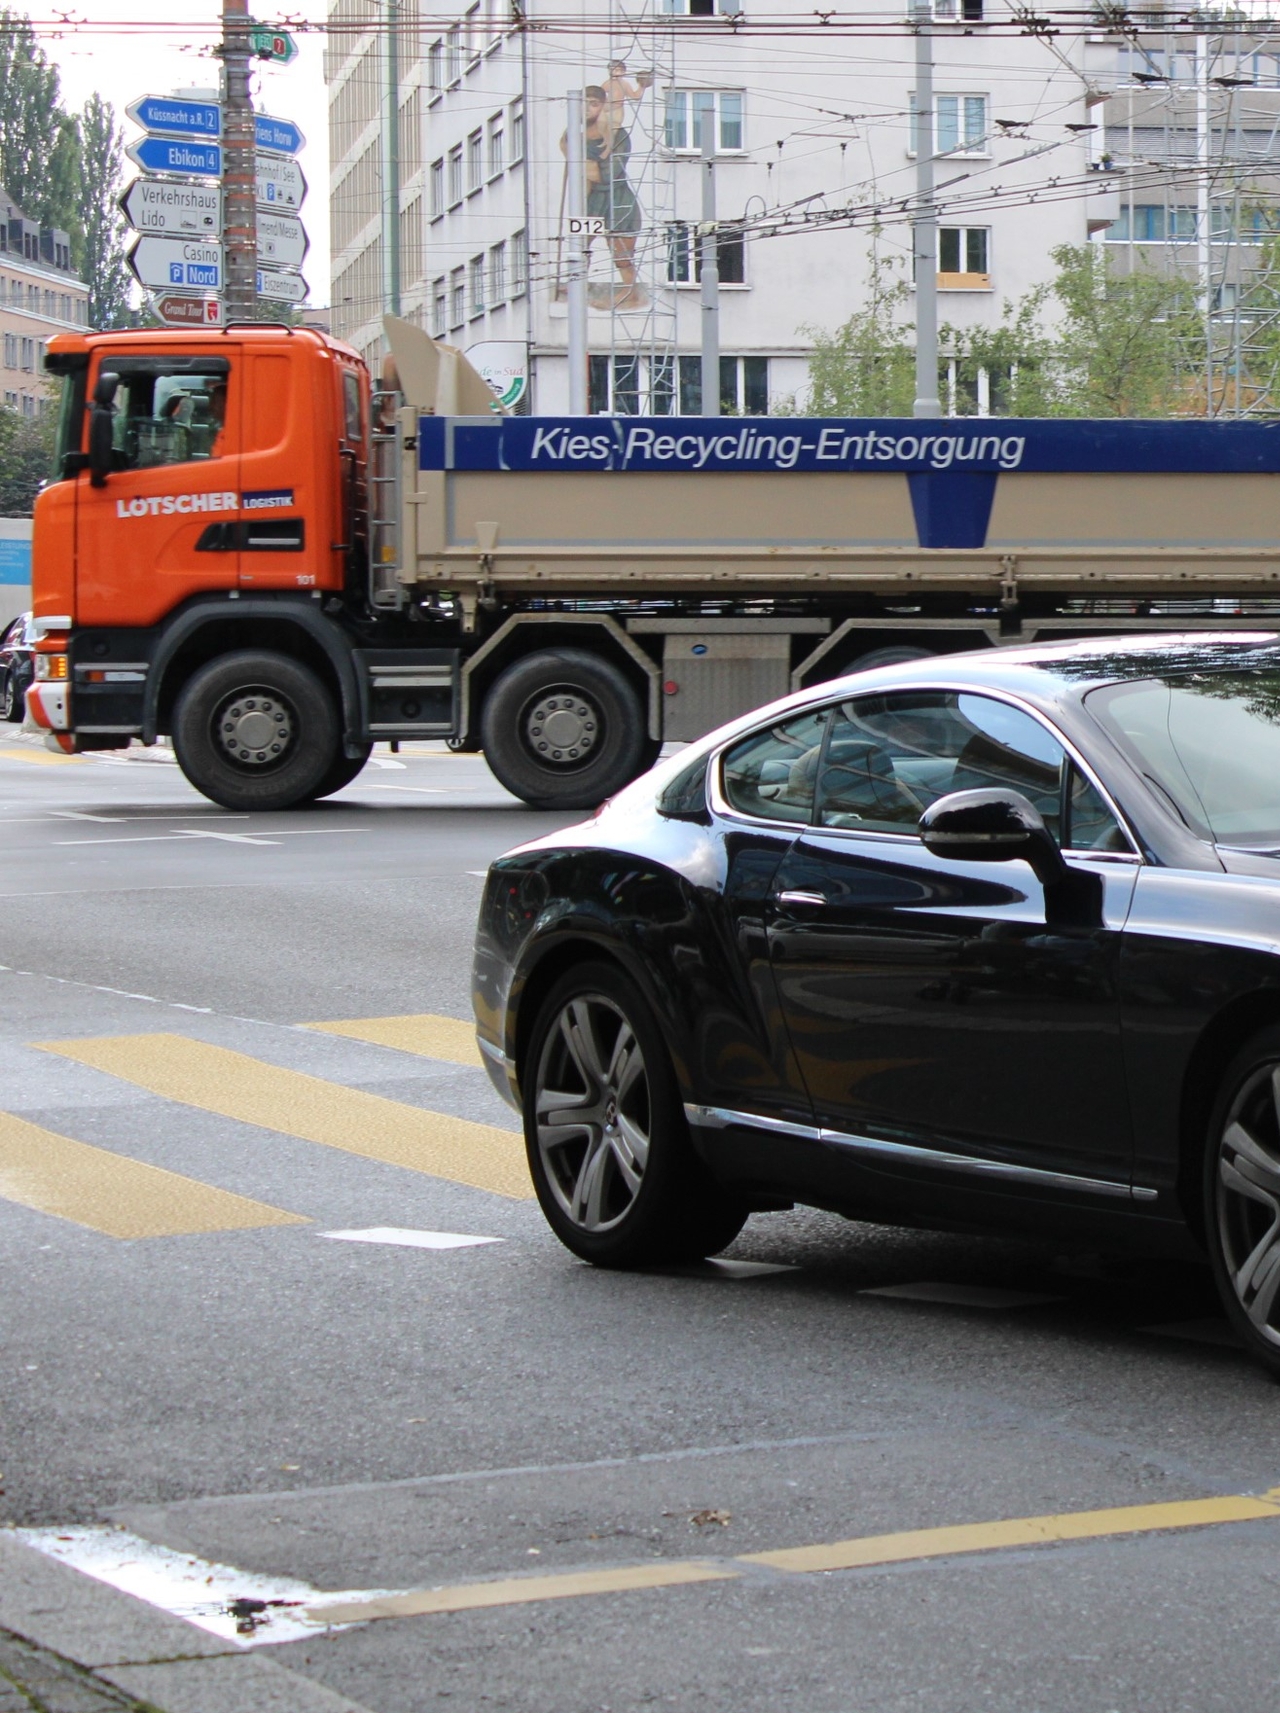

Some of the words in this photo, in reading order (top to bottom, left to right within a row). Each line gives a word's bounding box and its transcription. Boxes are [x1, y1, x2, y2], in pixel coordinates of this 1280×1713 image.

[147, 107, 188, 124] Küssnacht
[189, 113, 204, 126] a.R.
[208, 112, 214, 127] 2
[256, 124, 272, 142] riens
[273, 127, 292, 146] Horw
[168, 148, 205, 167] Ebikon
[208, 153, 215, 167] 4
[142, 186, 217, 209] Verkehrshaus
[141, 210, 165, 227] Lido
[570, 220, 603, 234] D12
[183, 245, 218, 263] Casino
[189, 266, 216, 284] Nord
[264, 275, 299, 295] Eiszentrum
[164, 301, 187, 316] Grand
[188, 303, 203, 317] Tour
[503, 366, 524, 376] Sud
[117, 492, 239, 518] LÖTSCHER
[243, 496, 293, 509] LOGISTIK
[296, 575, 316, 586] 101
